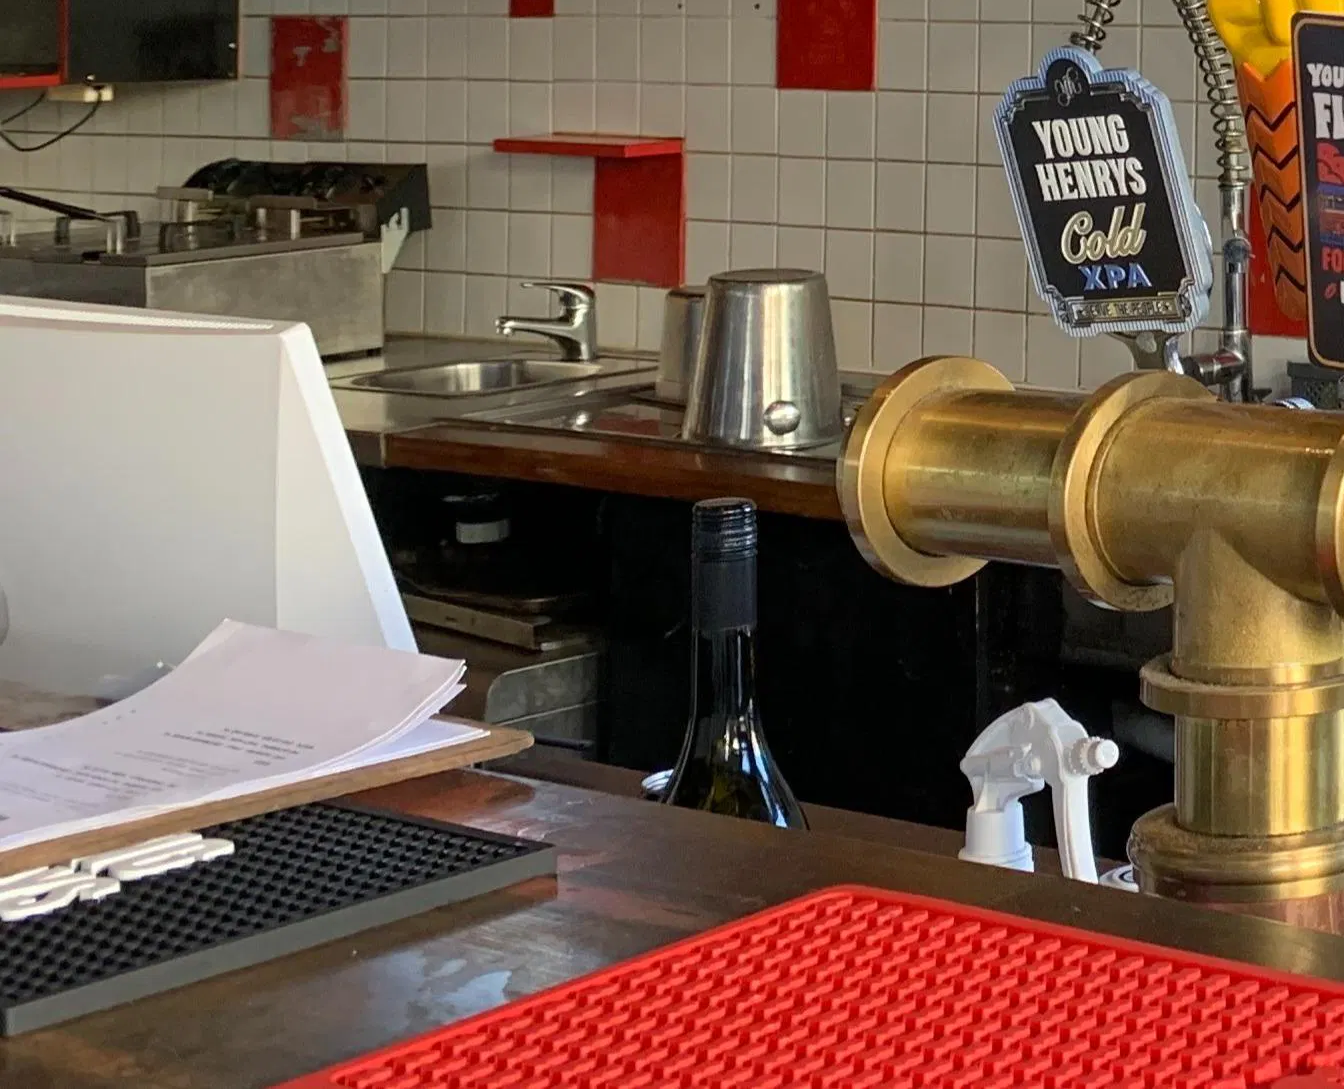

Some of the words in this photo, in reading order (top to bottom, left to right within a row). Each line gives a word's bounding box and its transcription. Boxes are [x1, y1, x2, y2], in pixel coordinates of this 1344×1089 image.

[1031, 113, 1130, 159] YOUNG
[1035, 157, 1147, 203] HENRYS
[1060, 202, 1148, 265] Cold
[1078, 263, 1153, 291] XPA
